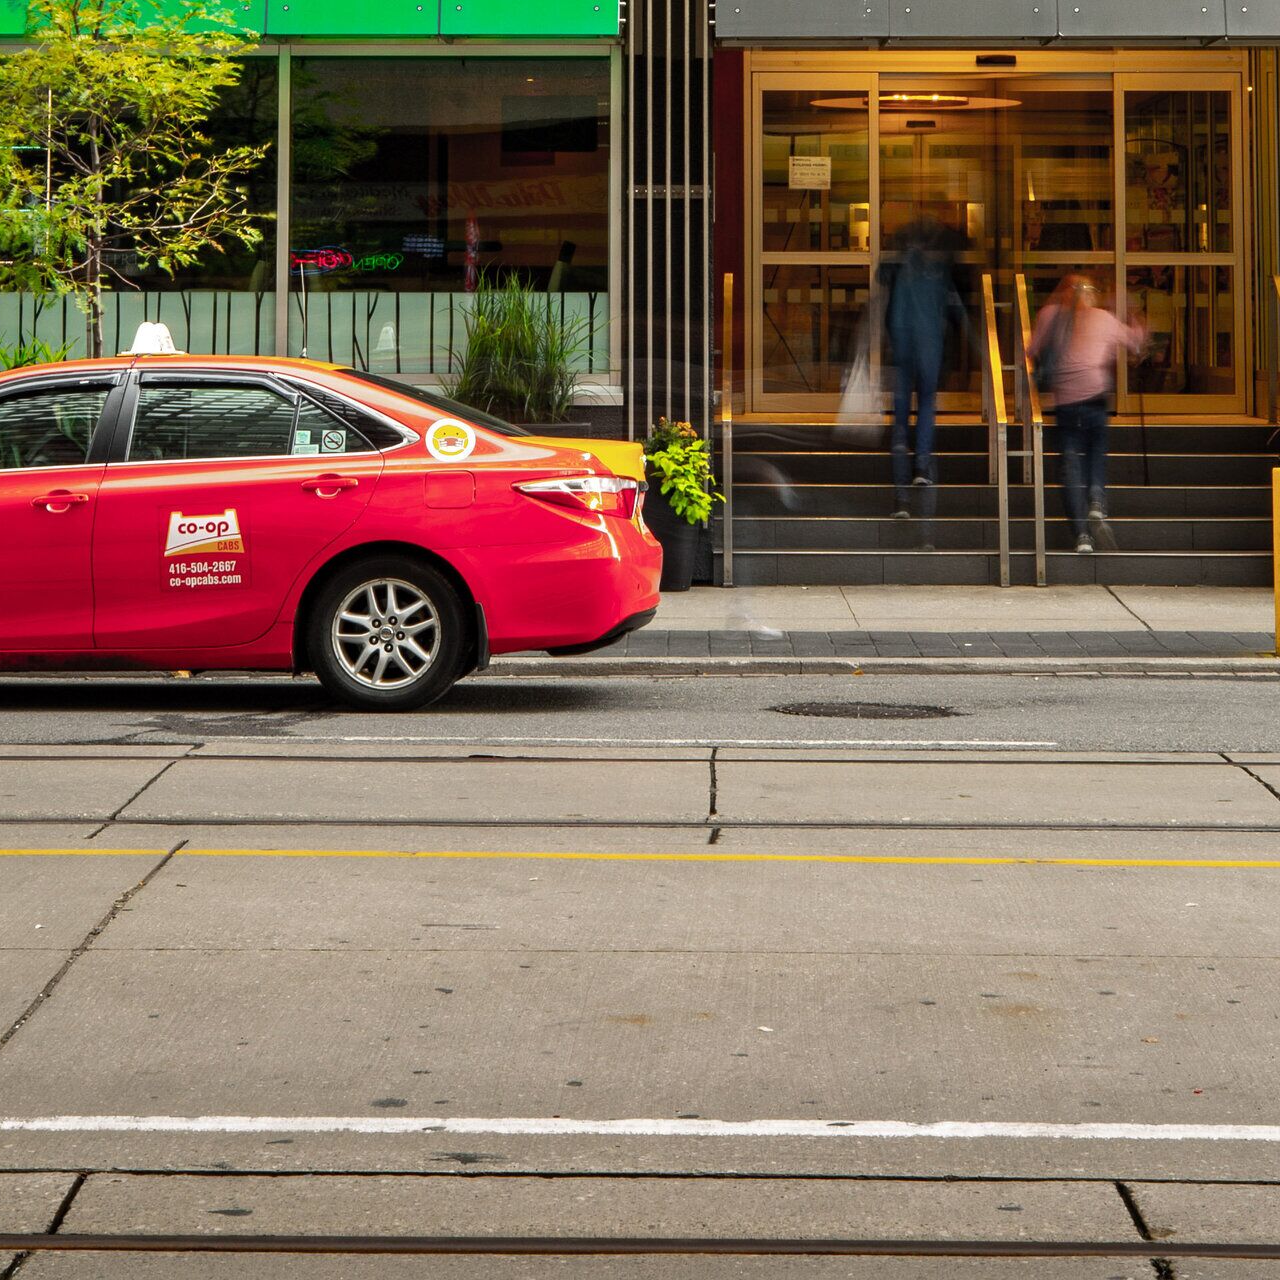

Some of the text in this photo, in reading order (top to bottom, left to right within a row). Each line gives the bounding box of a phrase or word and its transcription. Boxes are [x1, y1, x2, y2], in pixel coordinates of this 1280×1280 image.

[177, 521, 229, 537] co-op
[217, 540, 240, 551] CABS
[169, 560, 237, 575] 416-504-2667
[169, 573, 242, 588] co-opcabs.com
